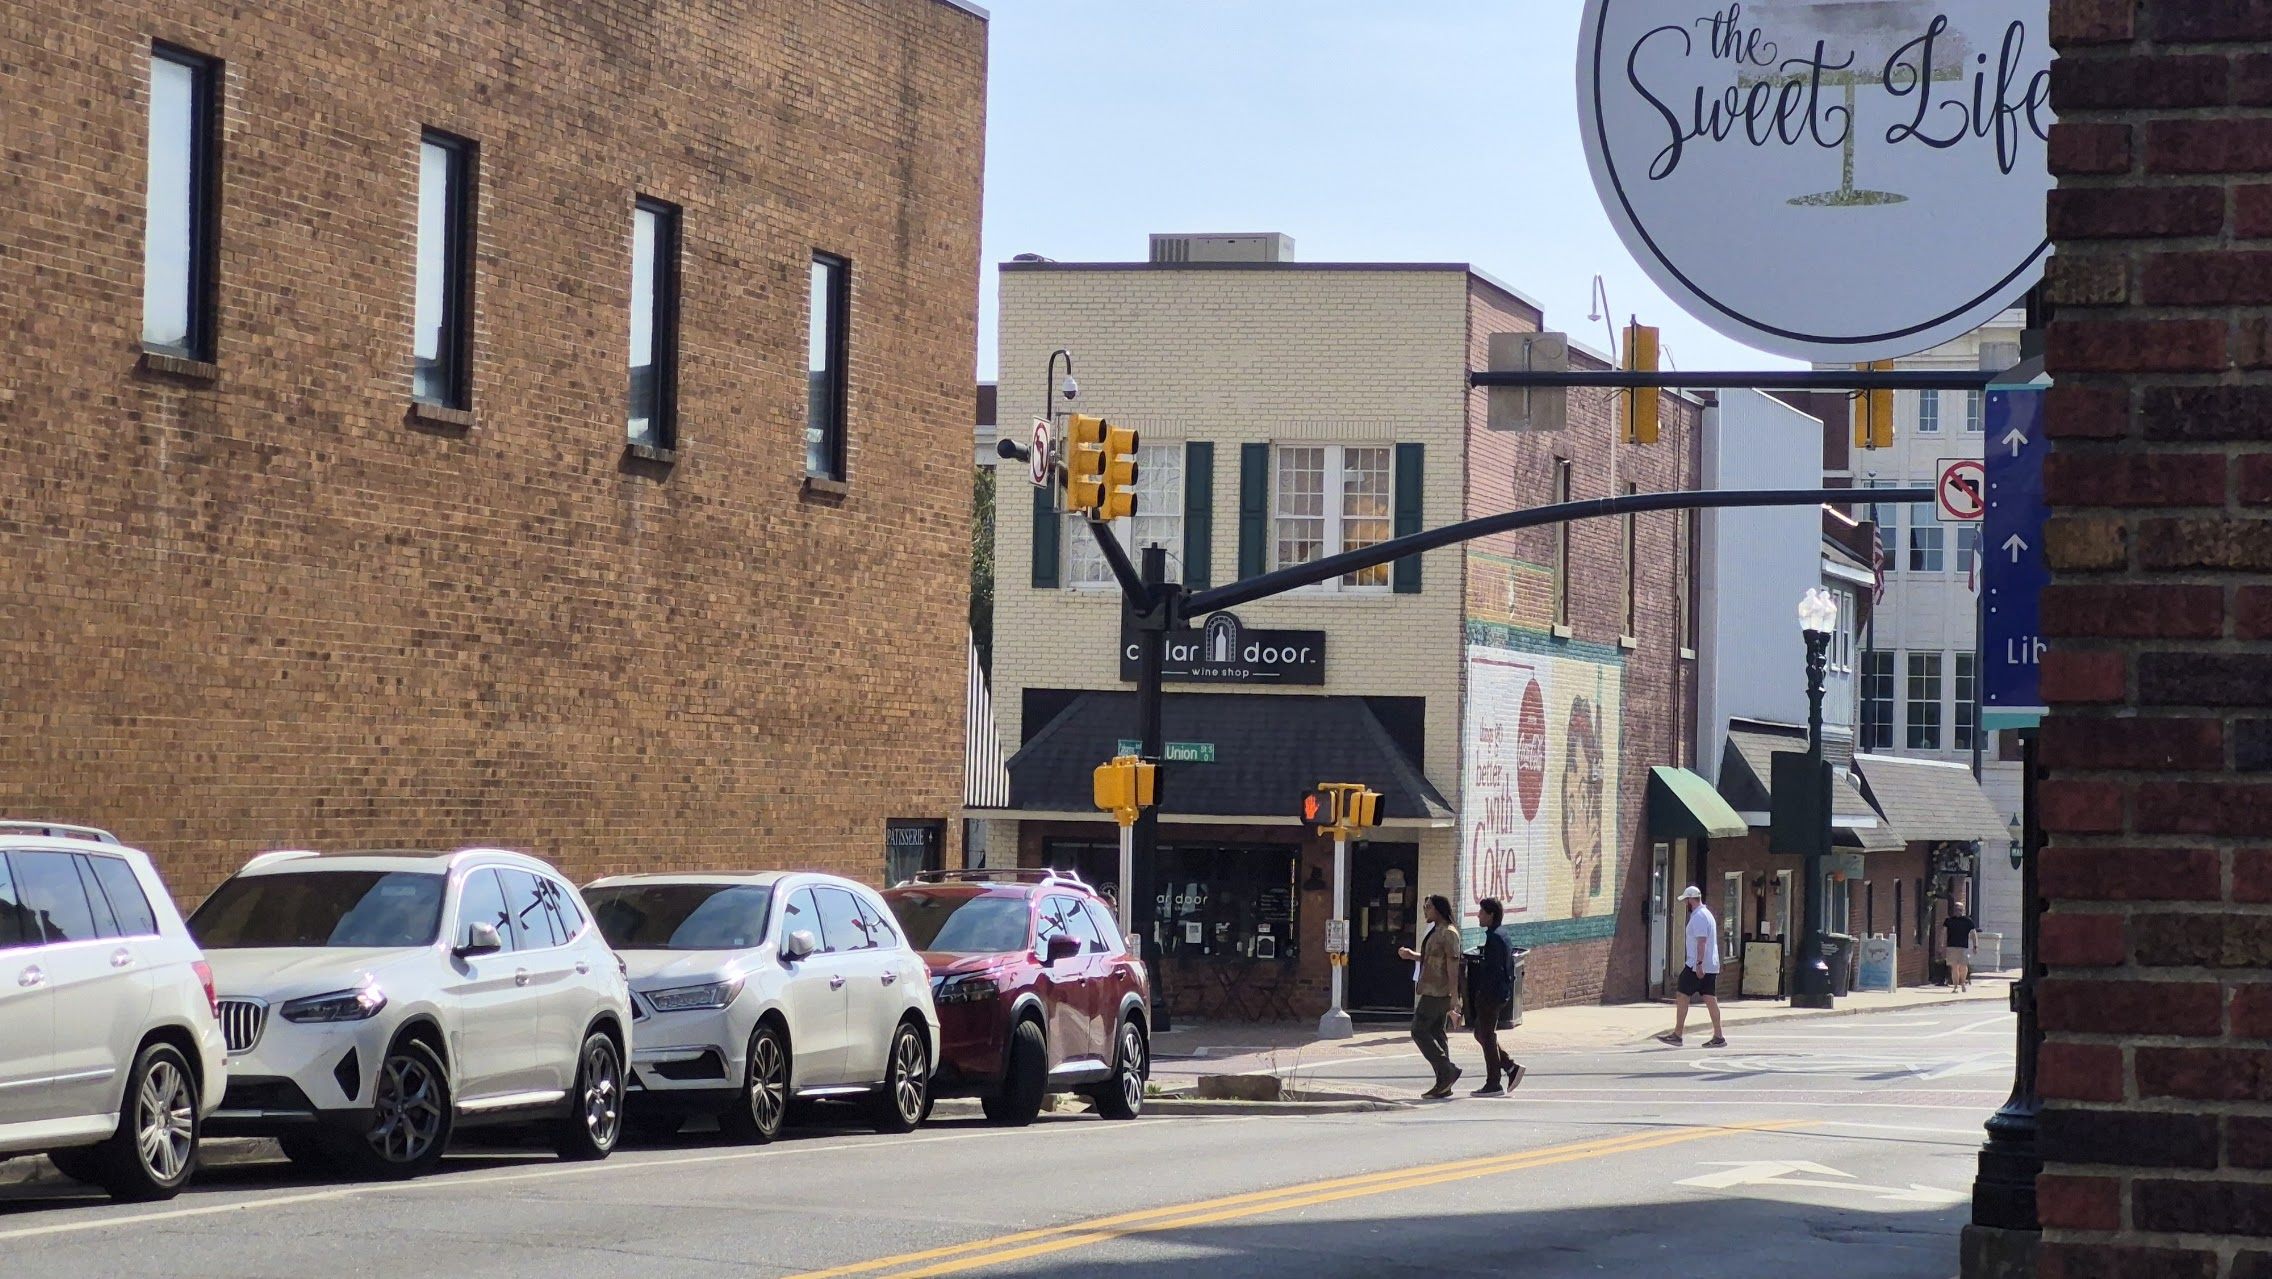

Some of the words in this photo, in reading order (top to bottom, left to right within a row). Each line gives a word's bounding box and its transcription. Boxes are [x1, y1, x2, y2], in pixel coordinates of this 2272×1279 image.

[1695, 2, 1778, 66] the
[1627, 25, 1855, 181] Sweet
[1883, 14, 2050, 174] Life
[1126, 639, 1199, 662] clar
[1192, 667, 1218, 677] wine
[1222, 667, 1250, 680] shop
[1166, 745, 1198, 761] Union
[1475, 747, 1502, 788] better
[1485, 773, 1513, 835] with
[1472, 821, 1516, 905] Coke
[1175, 892, 1208, 905] door
